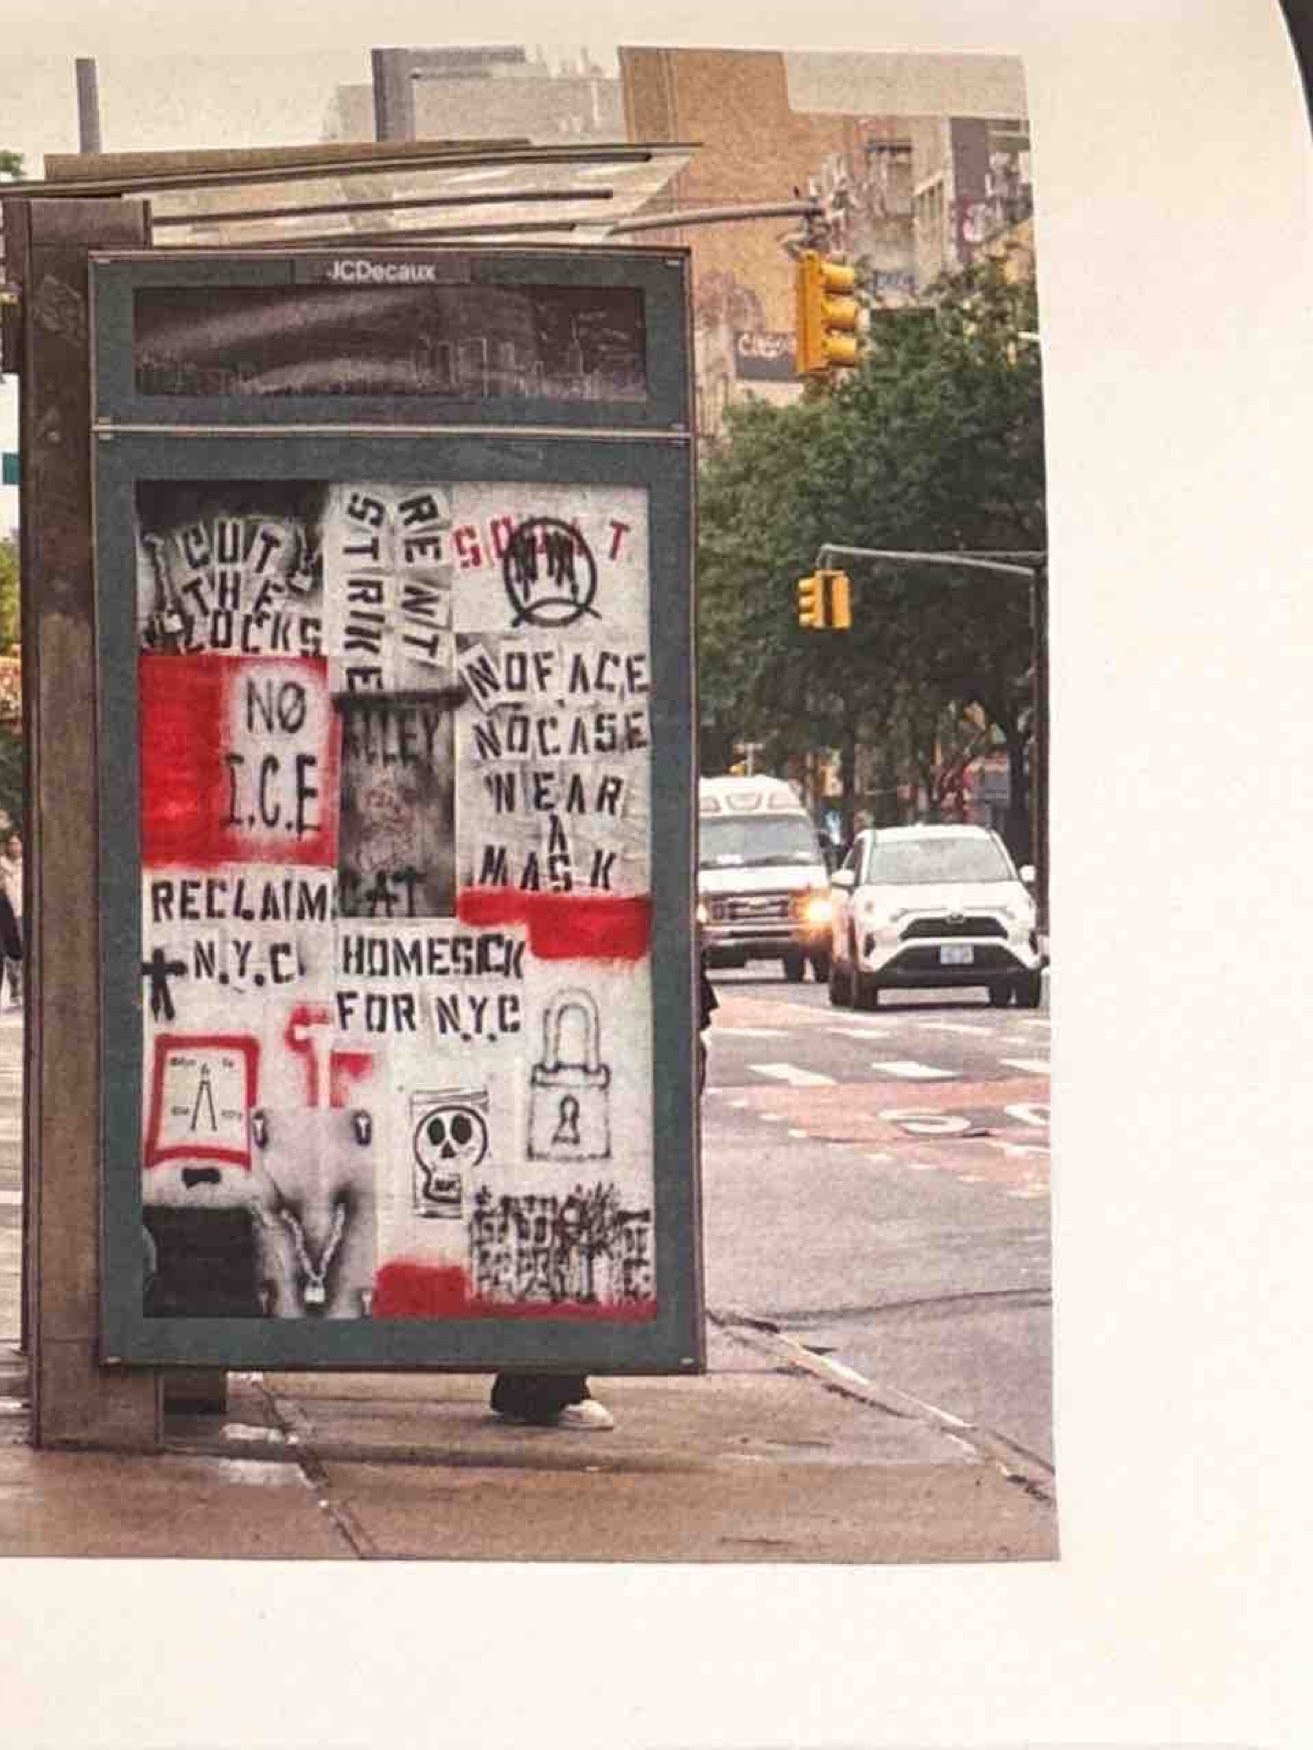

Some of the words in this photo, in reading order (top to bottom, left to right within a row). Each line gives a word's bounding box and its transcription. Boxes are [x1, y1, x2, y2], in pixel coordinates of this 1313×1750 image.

[329, 260, 436, 283] JCDecaux
[342, 493, 385, 690] STRIKE
[399, 494, 442, 659] RENT
[485, 772, 624, 816] WEAR
[548, 814, 568, 854] A
[477, 844, 616, 892] MASK
[151, 878, 328, 922] RECLAIM
[337, 991, 416, 1033] FOR
